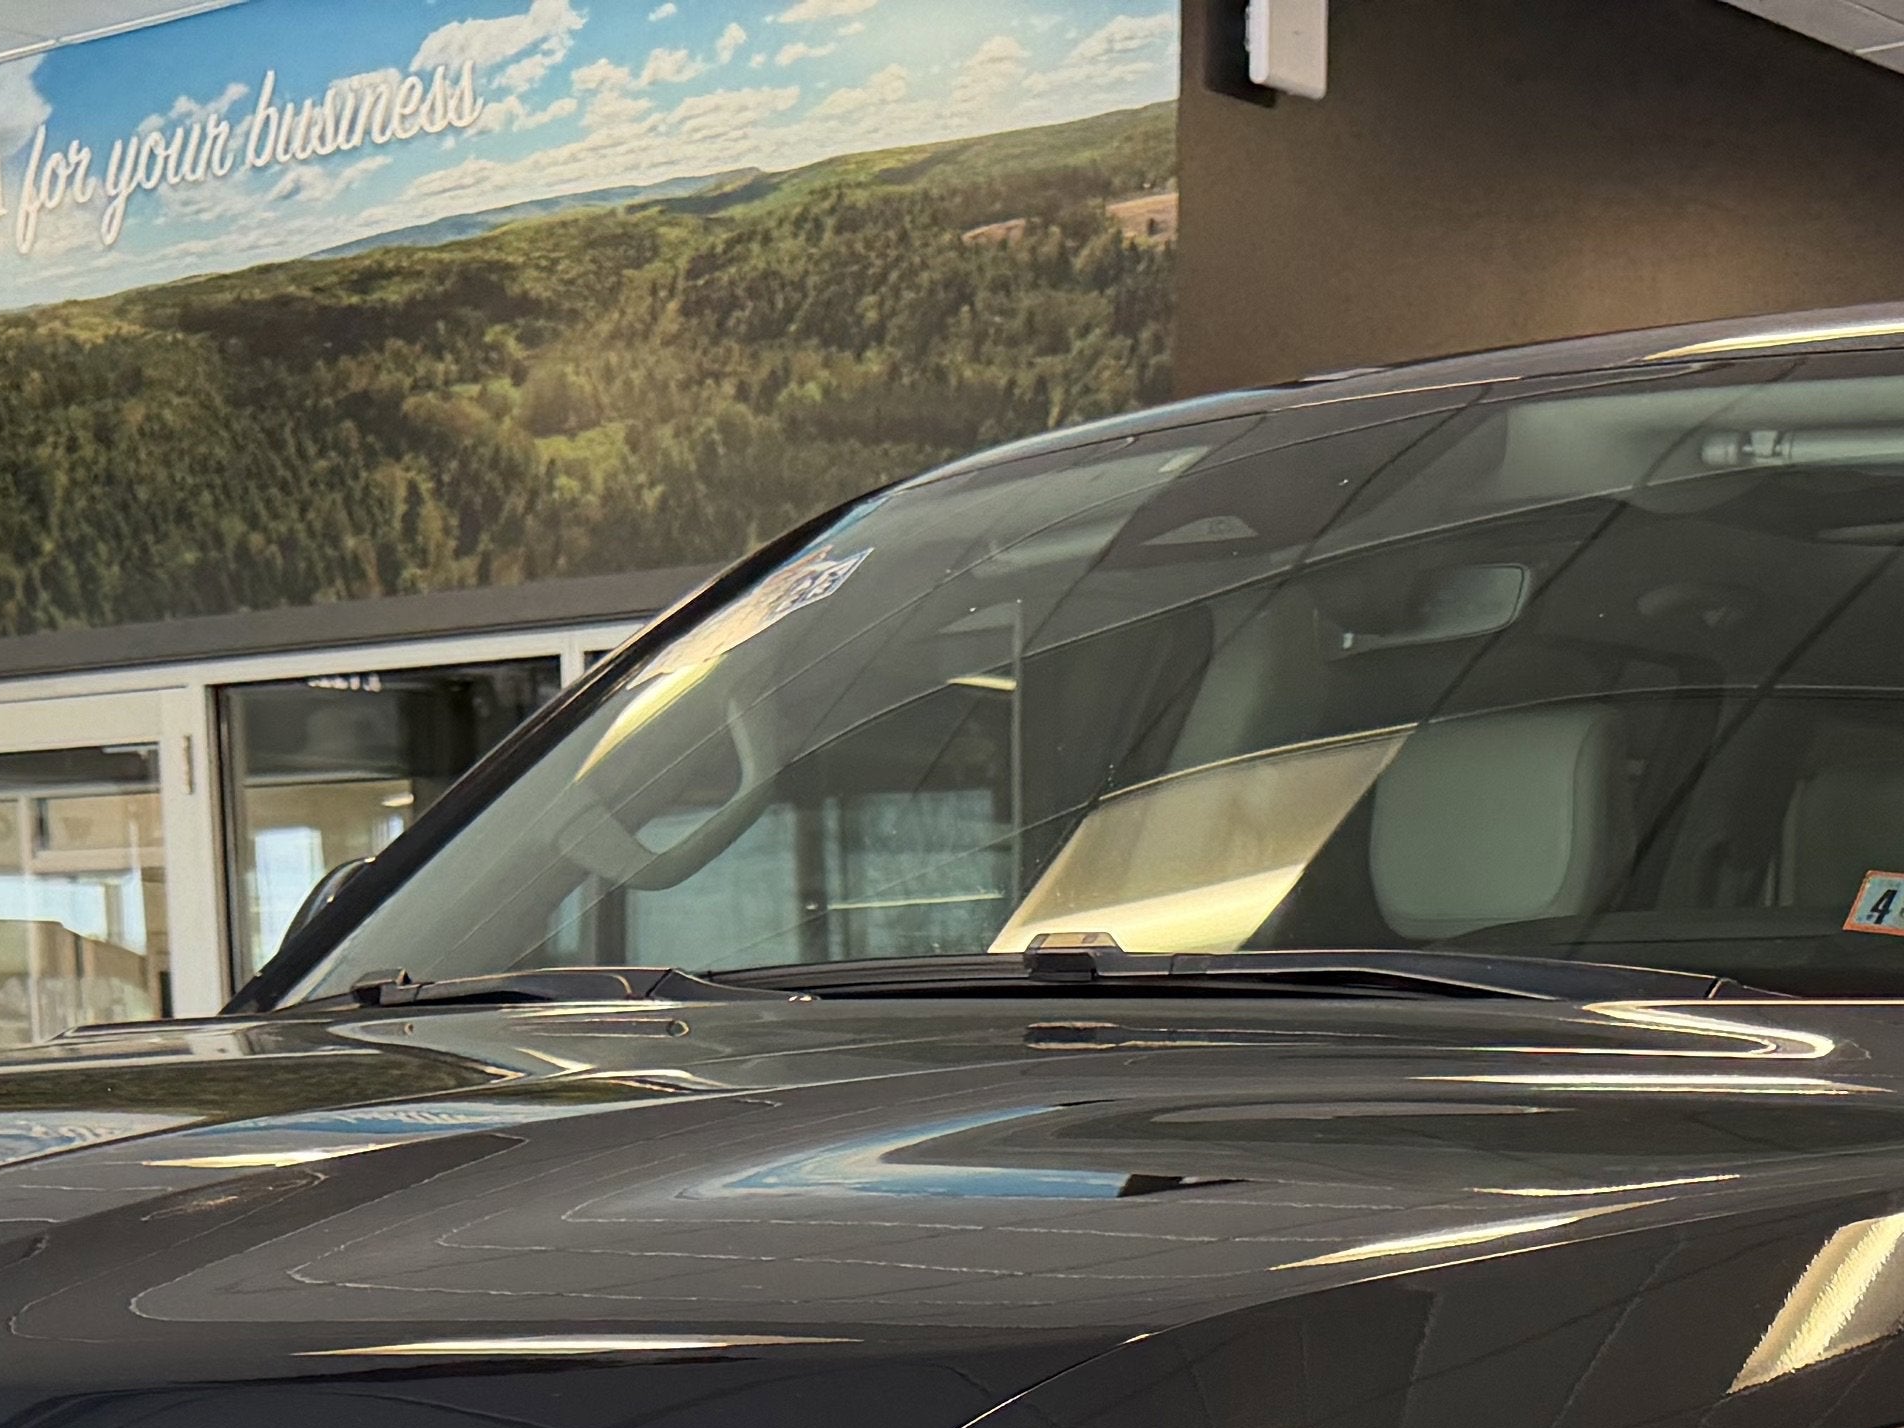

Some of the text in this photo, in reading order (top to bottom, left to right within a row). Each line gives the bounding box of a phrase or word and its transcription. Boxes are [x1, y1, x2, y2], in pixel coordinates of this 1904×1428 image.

[16, 124, 96, 254] for
[101, 113, 235, 246] your
[246, 60, 484, 168] business
[1867, 889, 1898, 925] 4
